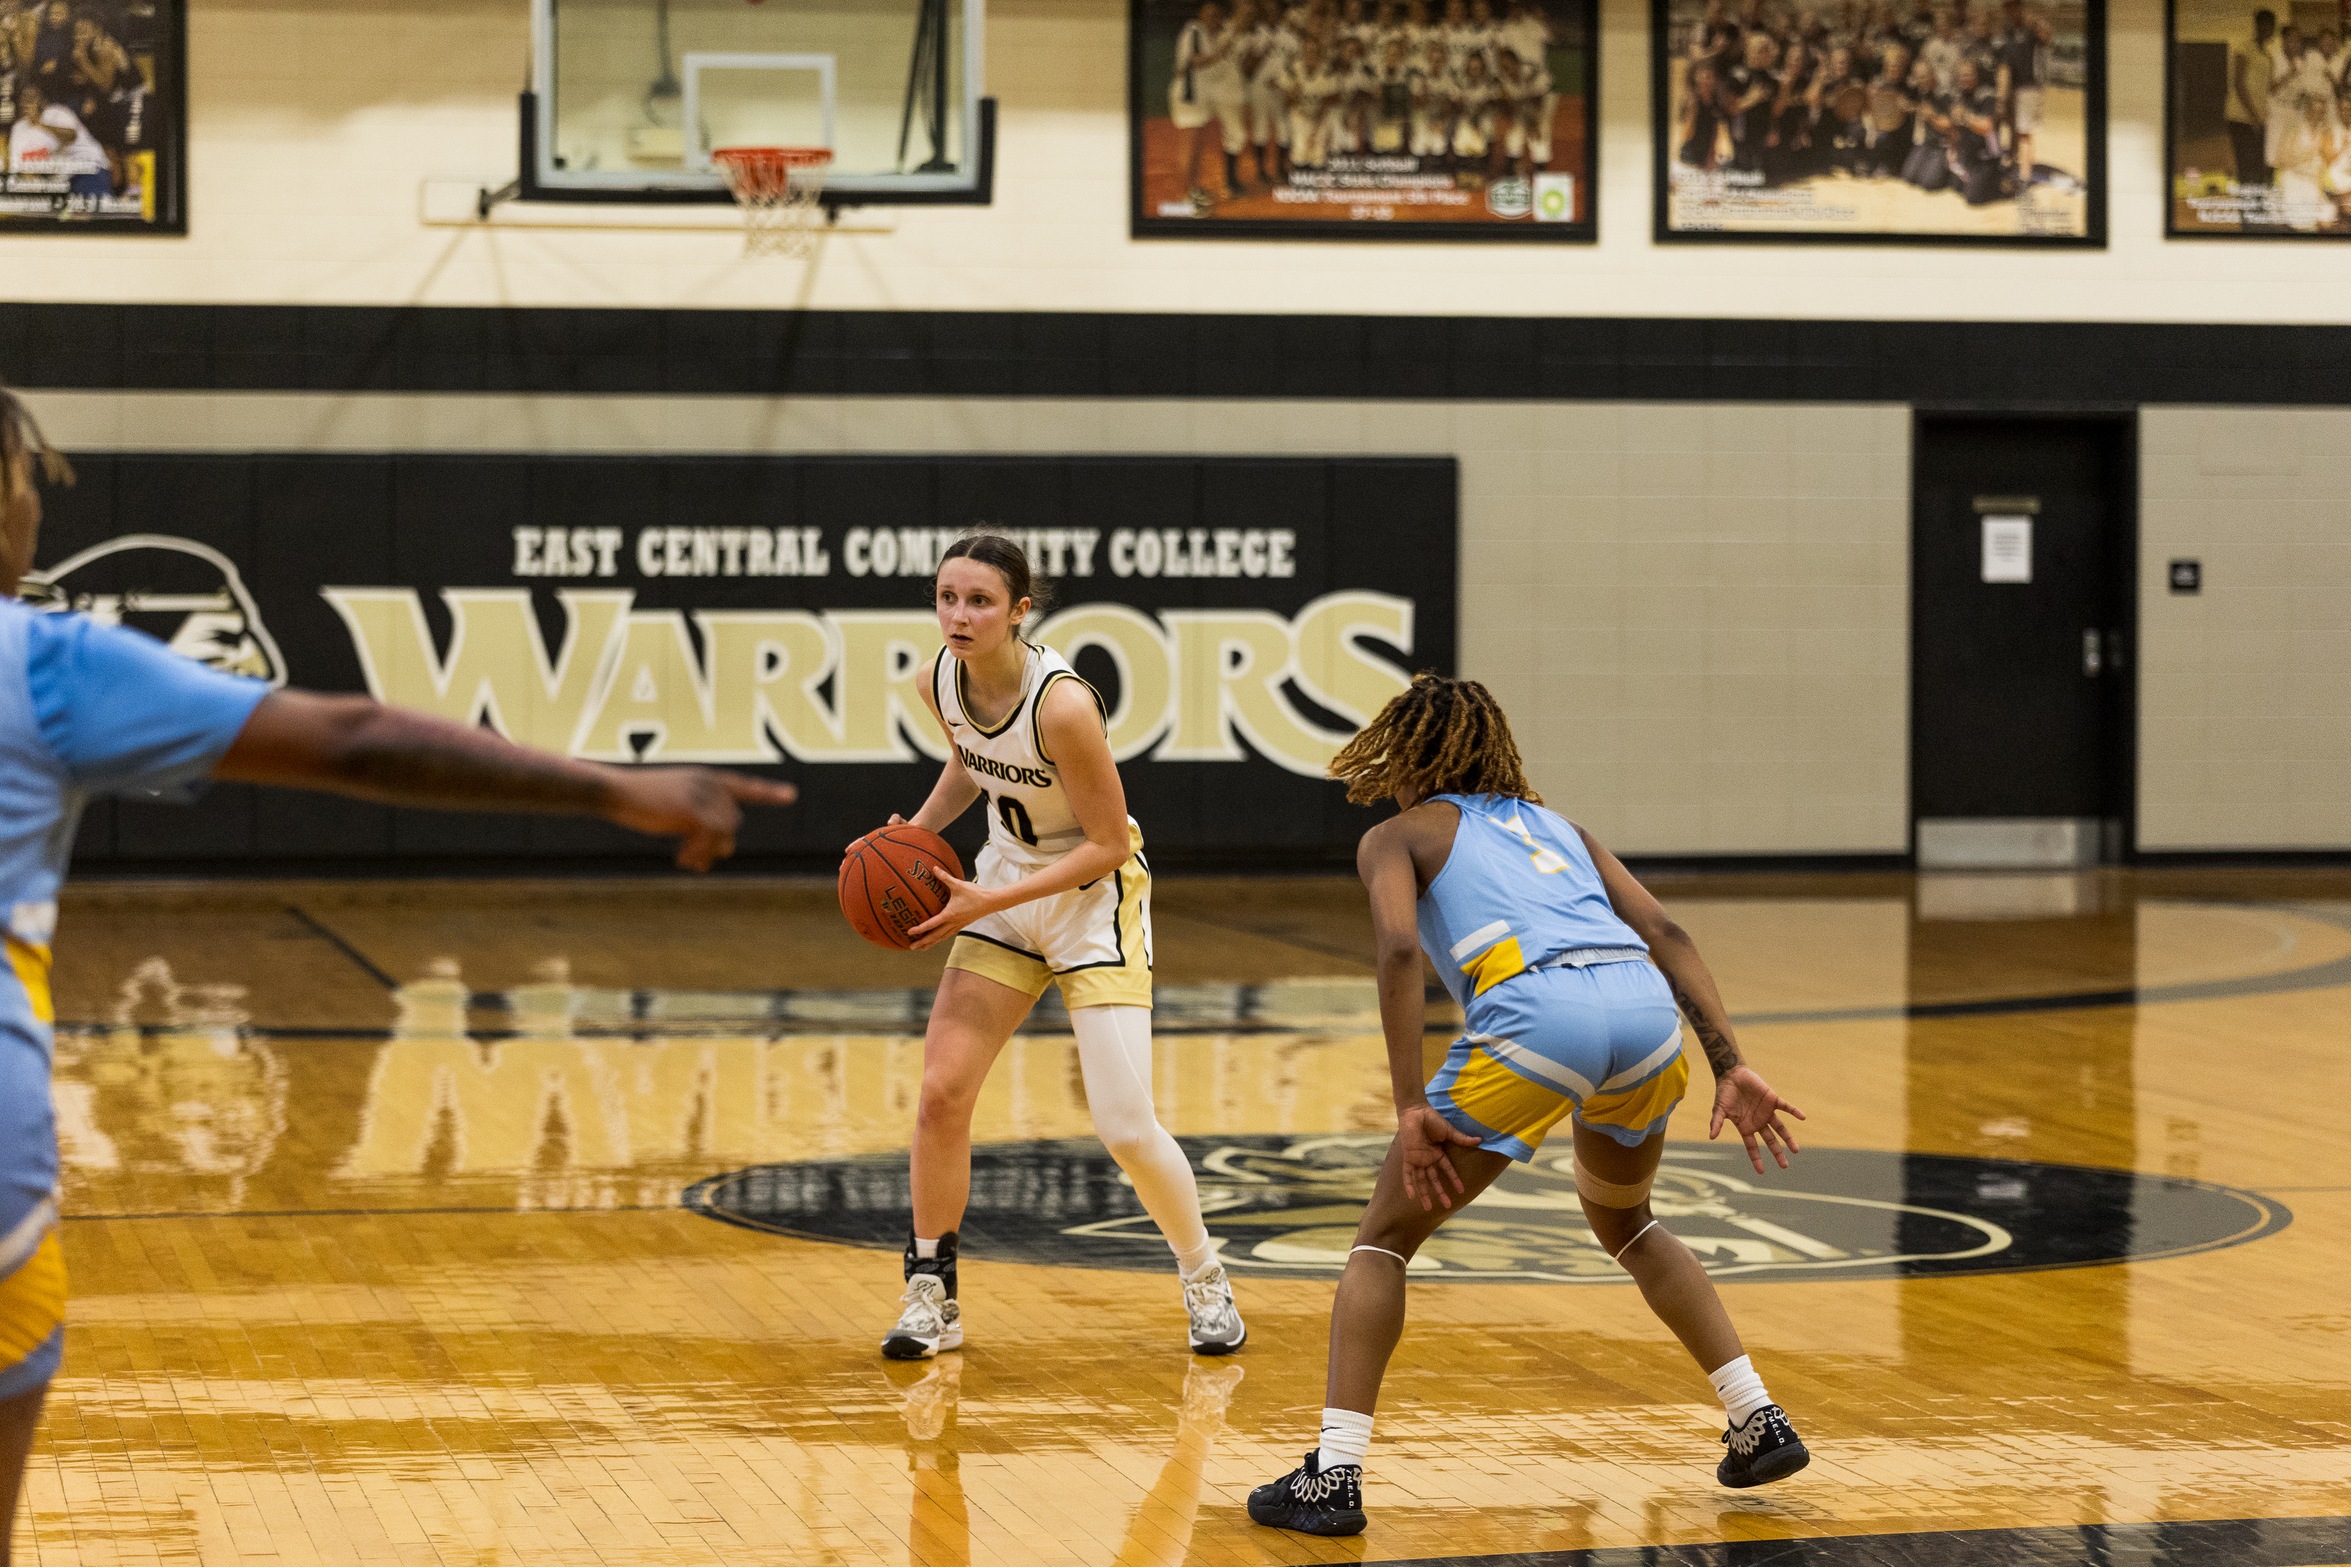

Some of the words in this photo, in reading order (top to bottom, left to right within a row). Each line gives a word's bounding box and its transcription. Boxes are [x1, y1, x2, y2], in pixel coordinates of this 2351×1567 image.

[512, 526, 623, 577] EAST
[636, 527, 830, 578] CENTRAL
[843, 527, 1100, 578] COMITY
[1108, 528, 1297, 579] COLLEGE
[318, 586, 1416, 781] WARRORS
[981, 787, 1039, 848] 0
